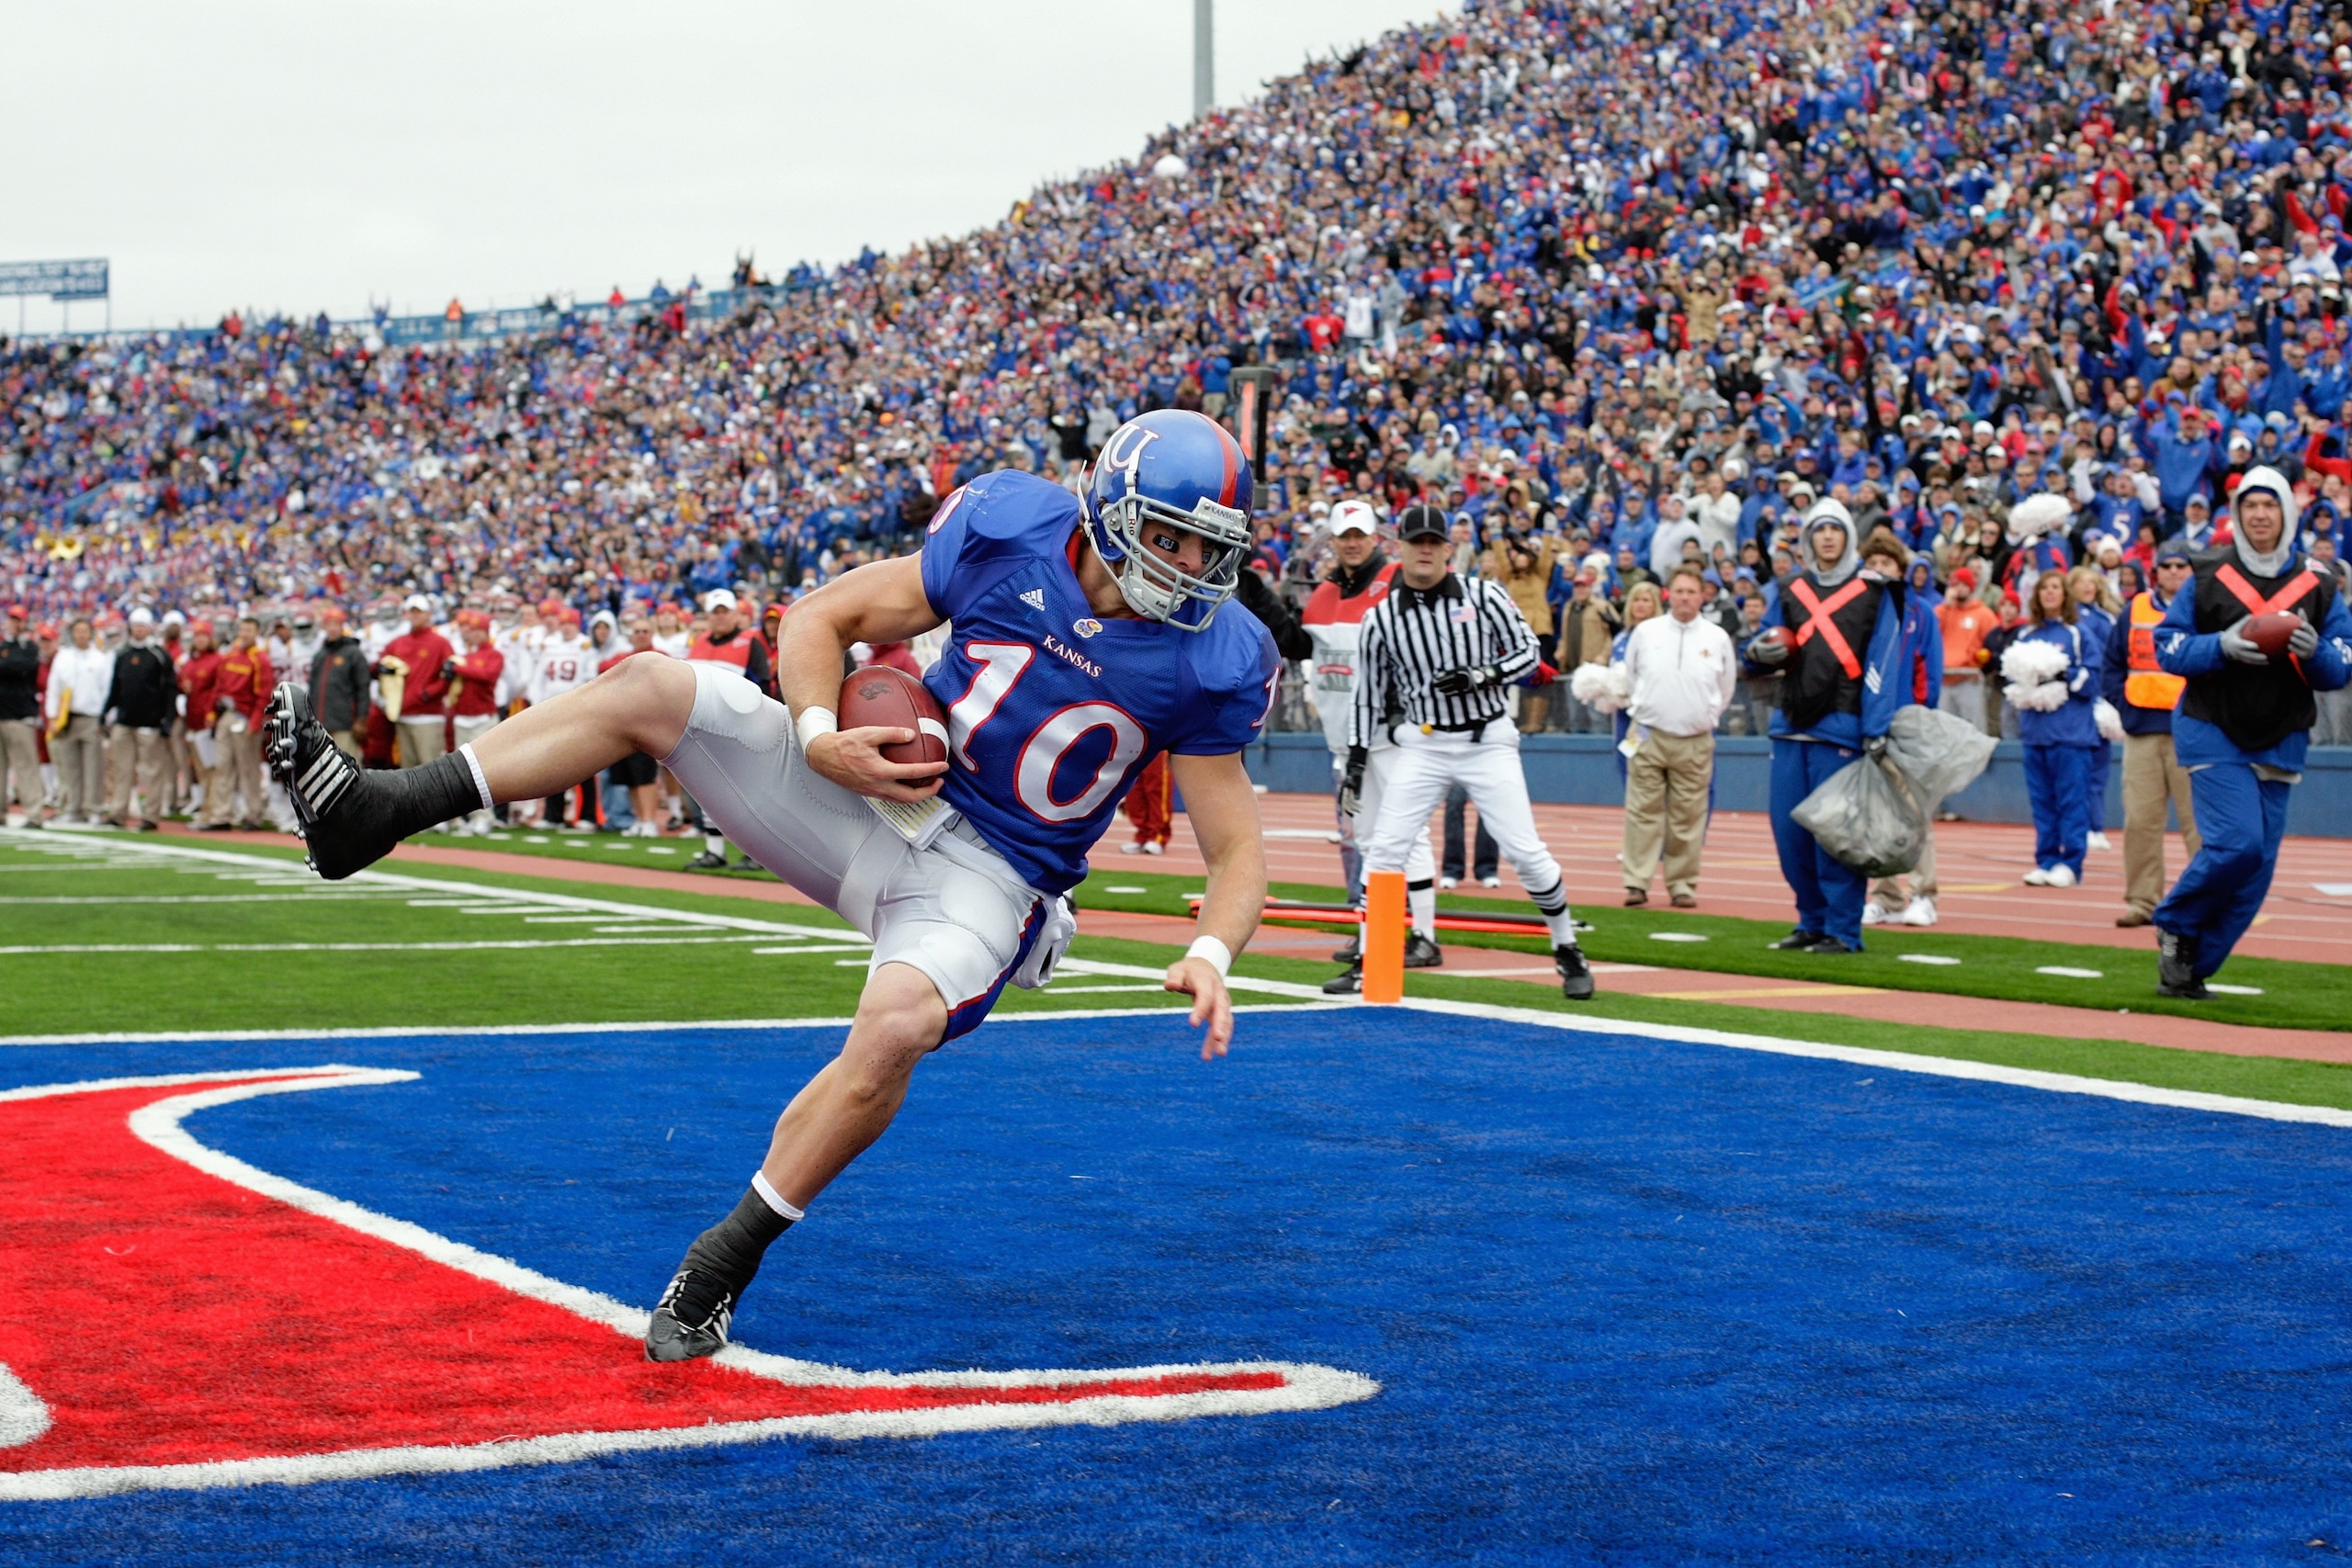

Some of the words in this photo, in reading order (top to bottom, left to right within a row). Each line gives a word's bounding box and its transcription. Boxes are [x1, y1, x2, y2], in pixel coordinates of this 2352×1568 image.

[2112, 511, 2131, 545] 5
[1159, 536, 1175, 550] KU
[1019, 593, 1046, 612] adidas
[1043, 634, 1103, 678] KANSAS
[545, 660, 578, 682] 49
[947, 639, 1149, 825] 10
